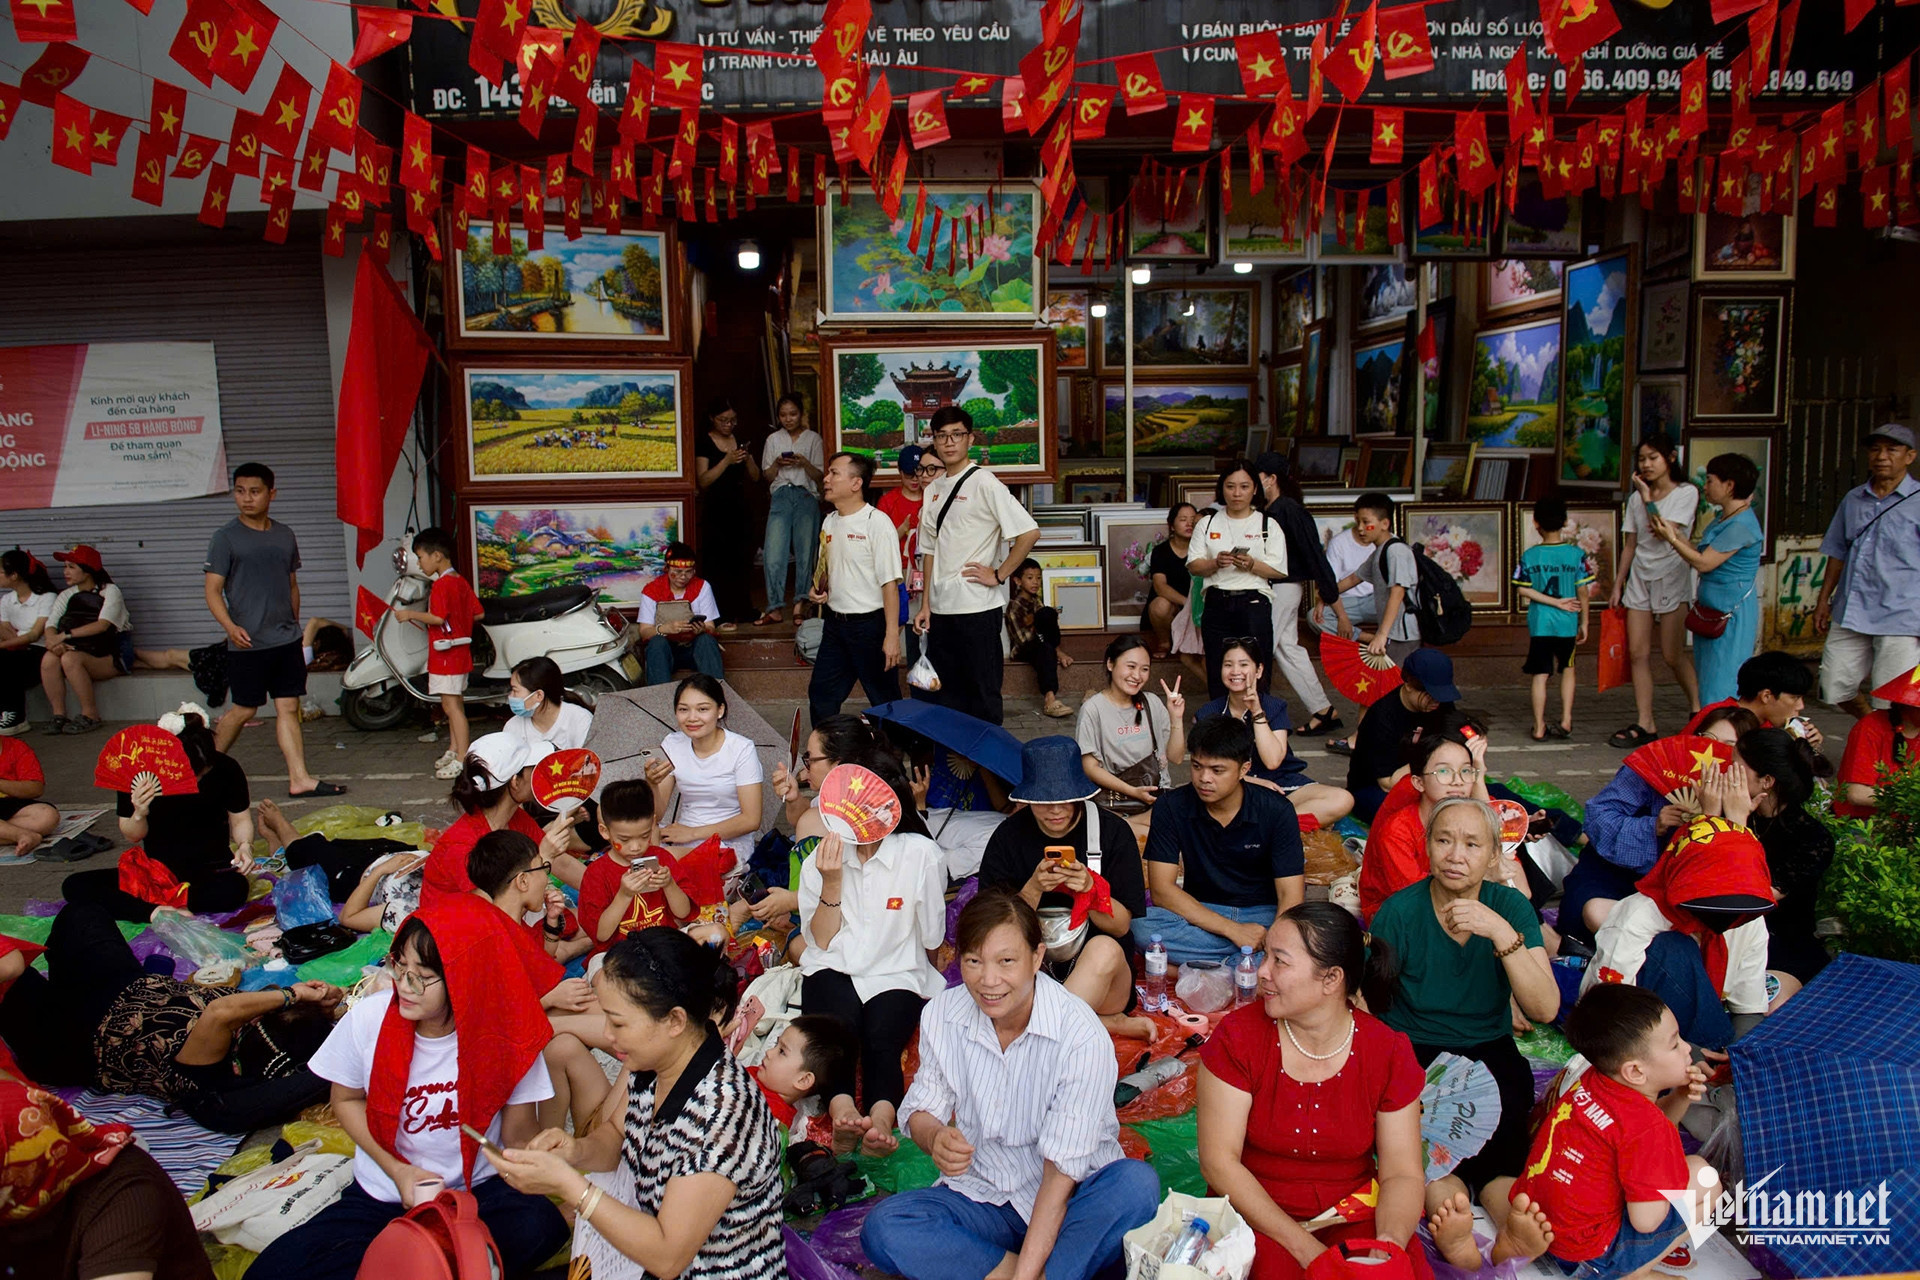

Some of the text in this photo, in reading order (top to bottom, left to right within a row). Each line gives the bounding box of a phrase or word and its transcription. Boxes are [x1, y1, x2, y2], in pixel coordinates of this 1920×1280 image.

[1202, 20, 1234, 38] BÁN
[1451, 16, 1481, 35] DẦU
[1486, 16, 1508, 35] SỐ
[718, 30, 739, 45] TƯ
[745, 25, 776, 45] VẤN
[893, 28, 935, 42] THEO
[942, 24, 972, 41] YÊU
[896, 48, 918, 65] ÂU
[1203, 47, 1238, 61] CUN
[1452, 42, 1483, 59] NHÀ
[1615, 42, 1666, 60] DƯỠNG
[1673, 43, 1698, 59] GIÁ
[719, 56, 772, 69] TRANH
[433, 88, 466, 110] ĐC:
[90, 396, 114, 405] Kính
[116, 395, 135, 404] mời
[159, 392, 190, 401] khách
[107, 405, 176, 416] đến cửa hàng
[91, 423, 127, 437] LI-NING
[142, 420, 168, 434] HÀNG
[127, 441, 154, 450] tham
[156, 440, 182, 450] quan
[123, 453, 145, 461] mua
[1583, 1102, 1614, 1131] NAM
